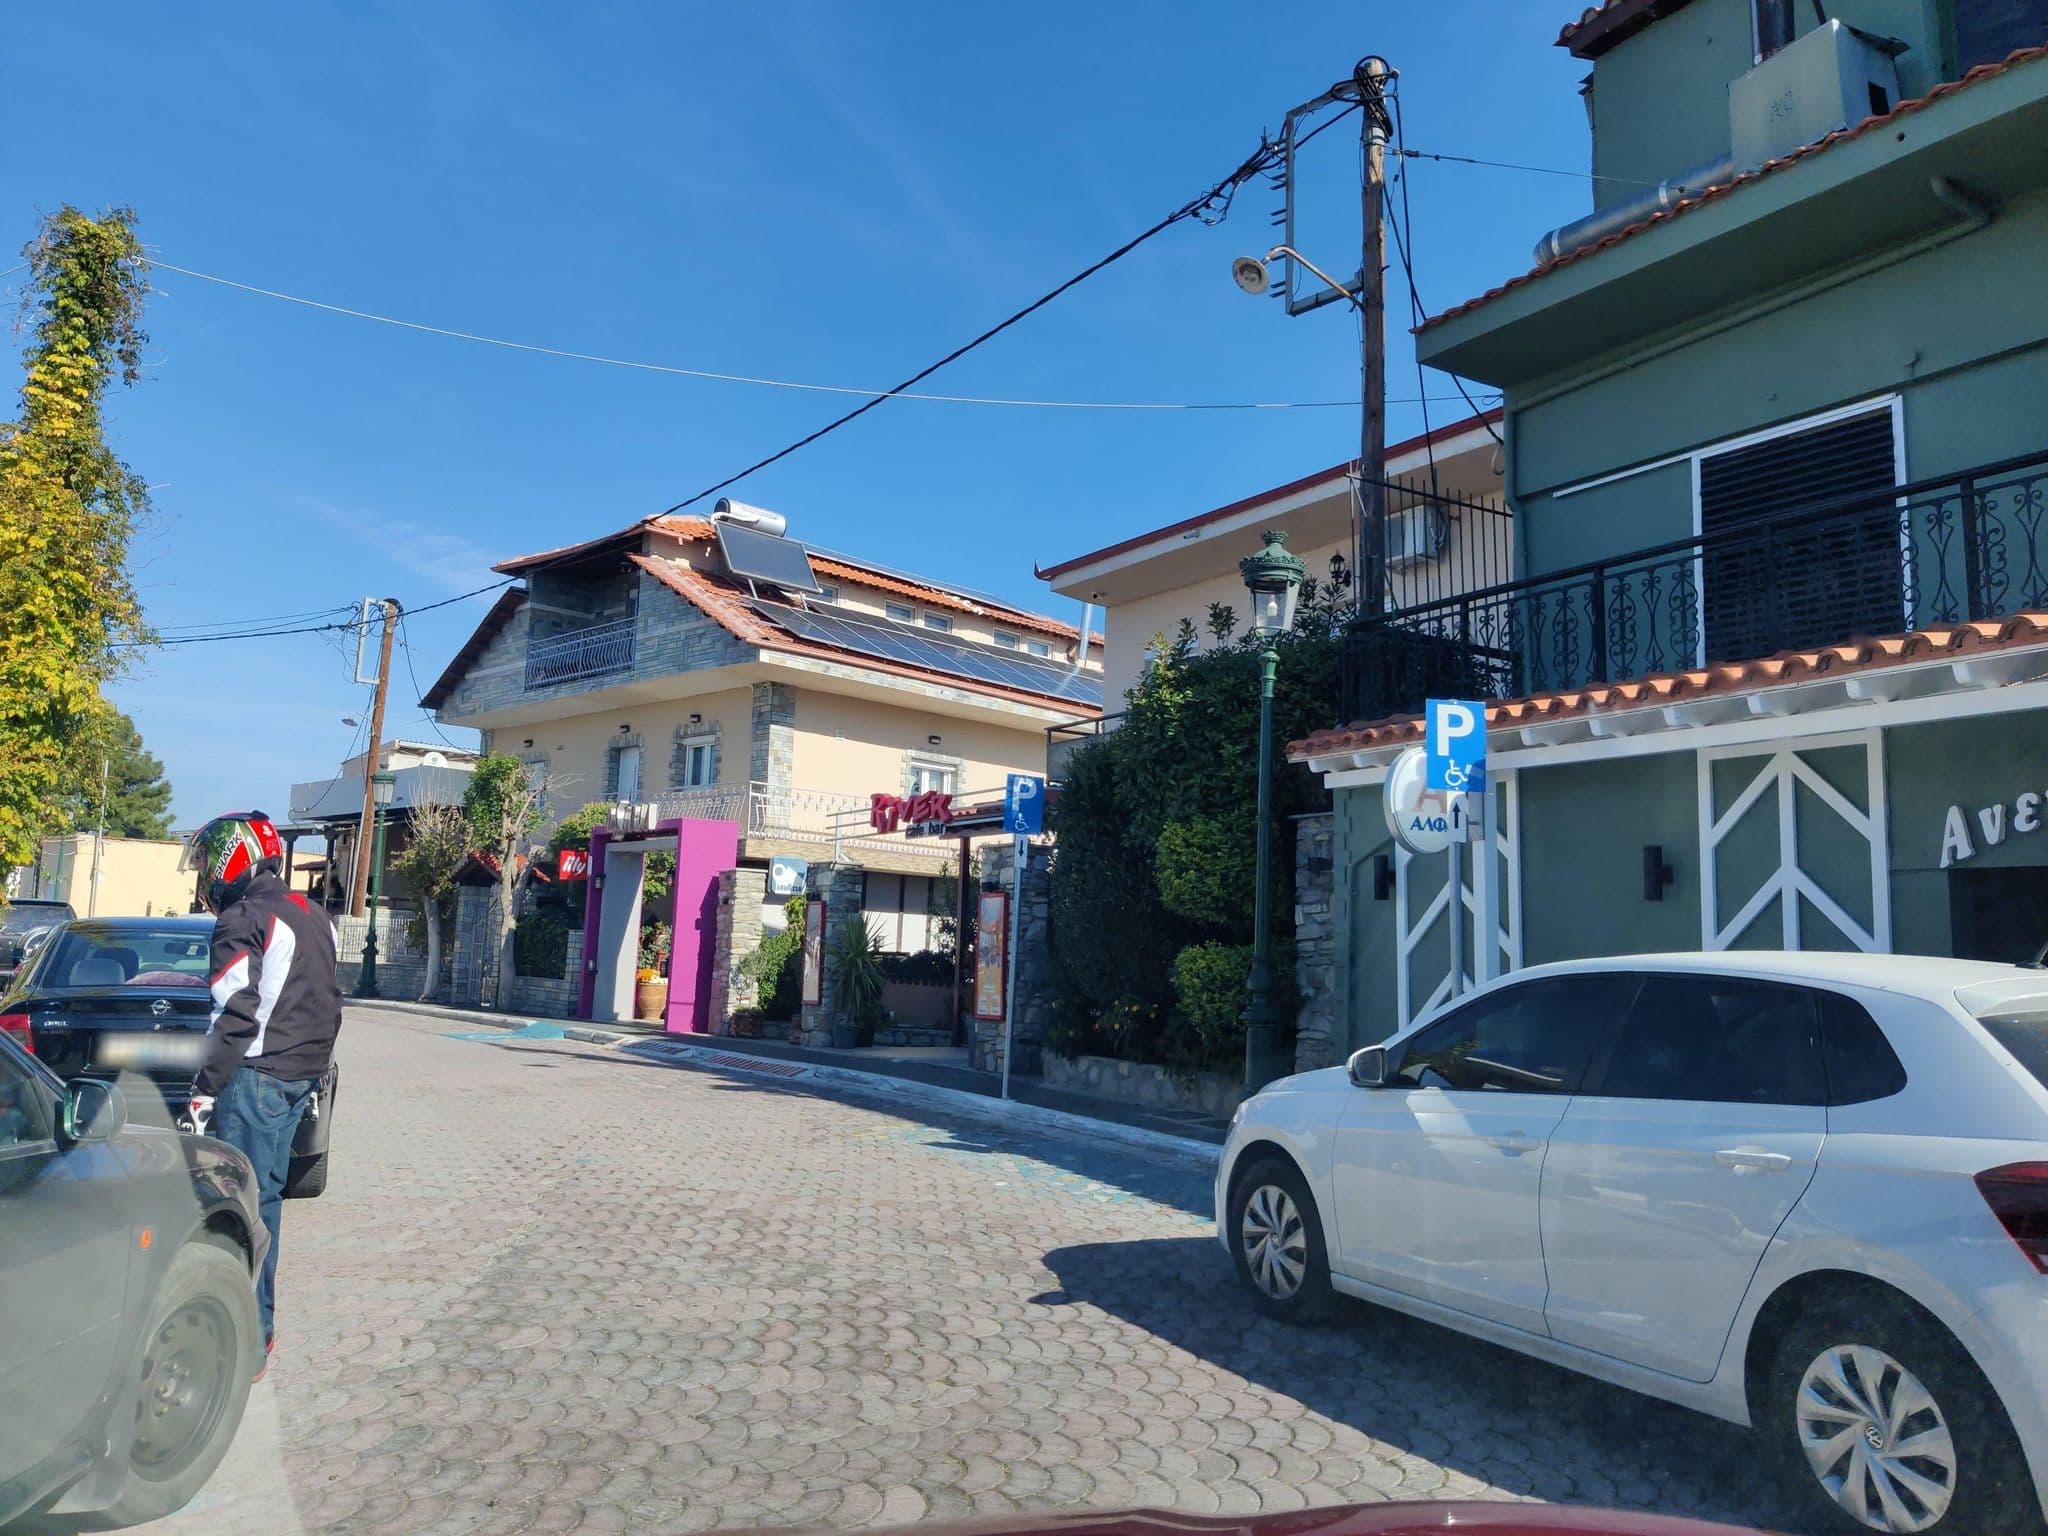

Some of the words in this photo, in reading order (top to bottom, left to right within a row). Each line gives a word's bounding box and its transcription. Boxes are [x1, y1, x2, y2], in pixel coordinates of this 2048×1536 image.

[1437, 703, 1475, 756] P
[1012, 776, 1037, 811] P
[929, 821, 945, 835] bar
[1410, 816, 1448, 832] ΑΛΦ
[214, 831, 244, 880] SHARK
[562, 855, 586, 876] illy
